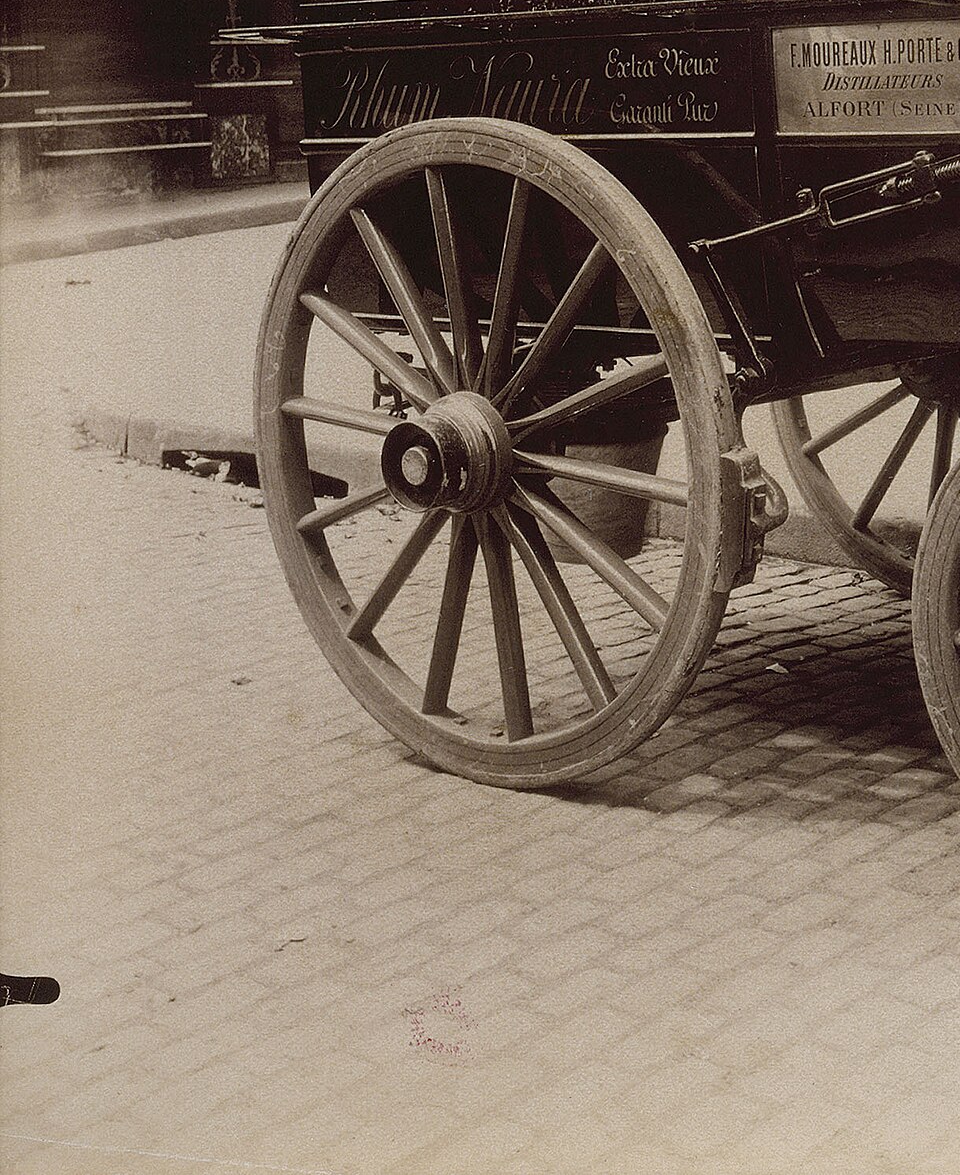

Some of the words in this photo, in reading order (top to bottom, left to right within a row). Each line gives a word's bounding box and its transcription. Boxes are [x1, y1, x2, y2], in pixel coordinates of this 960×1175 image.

[604, 47, 658, 79] Extra
[659, 47, 720, 76] Vieux
[677, 90, 718, 122] Pur
[802, 101, 885, 118] ALFORT
